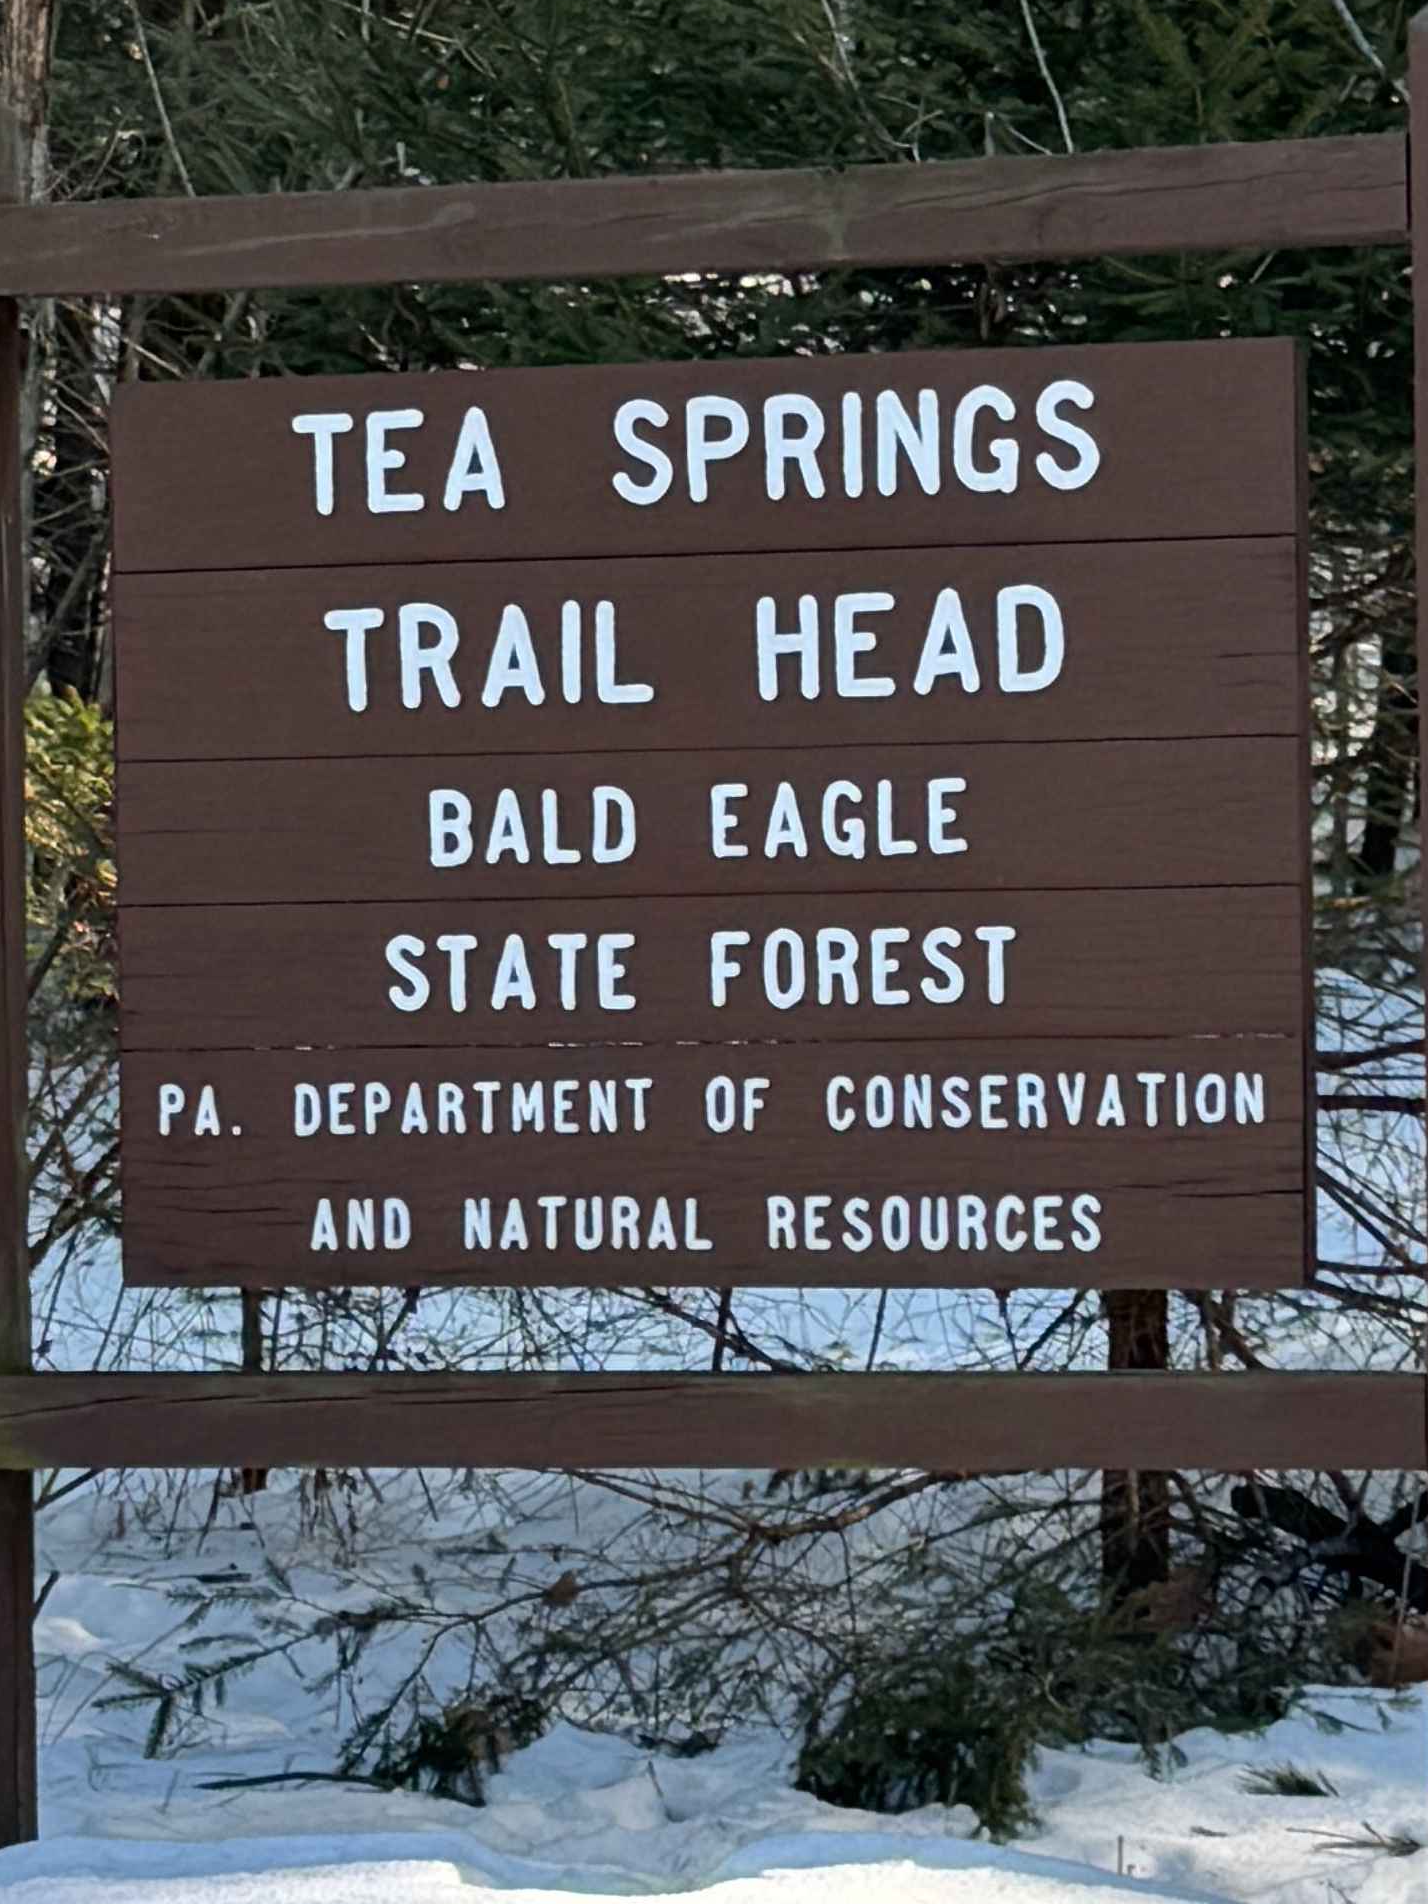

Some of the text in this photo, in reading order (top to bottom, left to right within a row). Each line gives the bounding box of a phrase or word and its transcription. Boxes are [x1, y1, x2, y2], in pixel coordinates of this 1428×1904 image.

[291, 379, 1102, 516] TEA SPRINGS
[323, 583, 1065, 713] TRAIL HEAD
[428, 777, 969, 868] BALD EAGLE
[385, 925, 1017, 1013] STATE FOREST
[158, 1071, 1266, 1137] PA. DEPARTMENT OF CONSERVATION
[310, 1193, 1103, 1253] AND NATURAL RESOURCES
